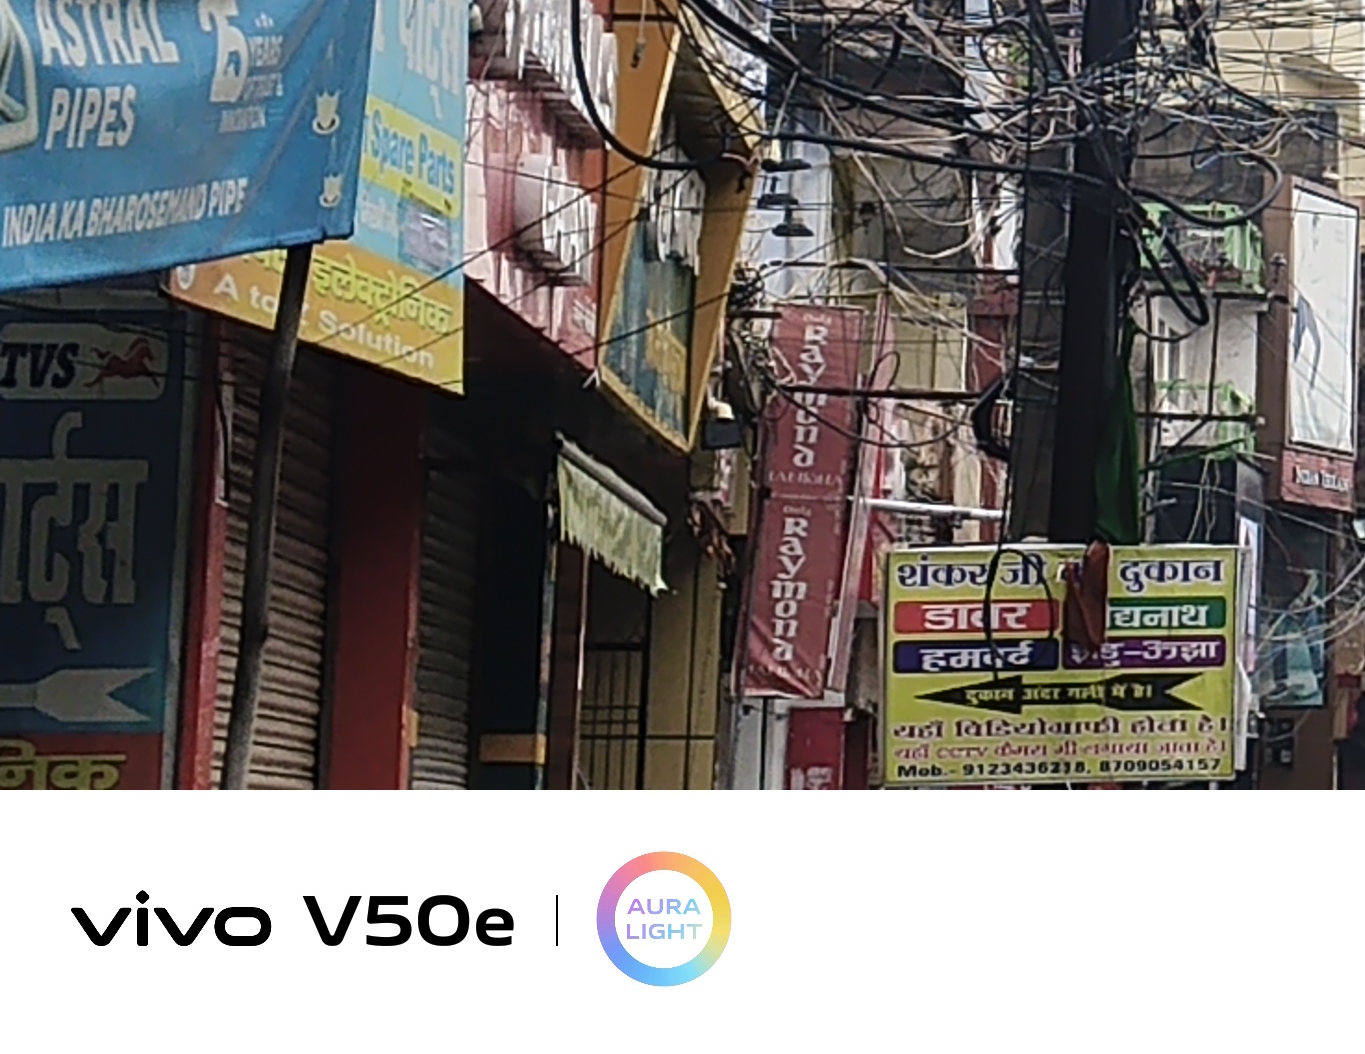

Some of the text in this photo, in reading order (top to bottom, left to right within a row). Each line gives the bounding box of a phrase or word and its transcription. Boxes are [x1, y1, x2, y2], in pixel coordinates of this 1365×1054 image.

[44, 83, 137, 150] PIPES
[369, 109, 454, 196] Spare Parts
[2, 177, 248, 247] INDIA KA BHAROSEMAND PIPE
[213, 273, 239, 302] A
[319, 309, 434, 369] Solution
[0, 343, 79, 389] TVS
[1118, 559, 1225, 593] दुकान
[1105, 605, 1210, 629] द्यनाथ
[964, 688, 1015, 705] दुकान
[1130, 714, 1188, 735] होता
